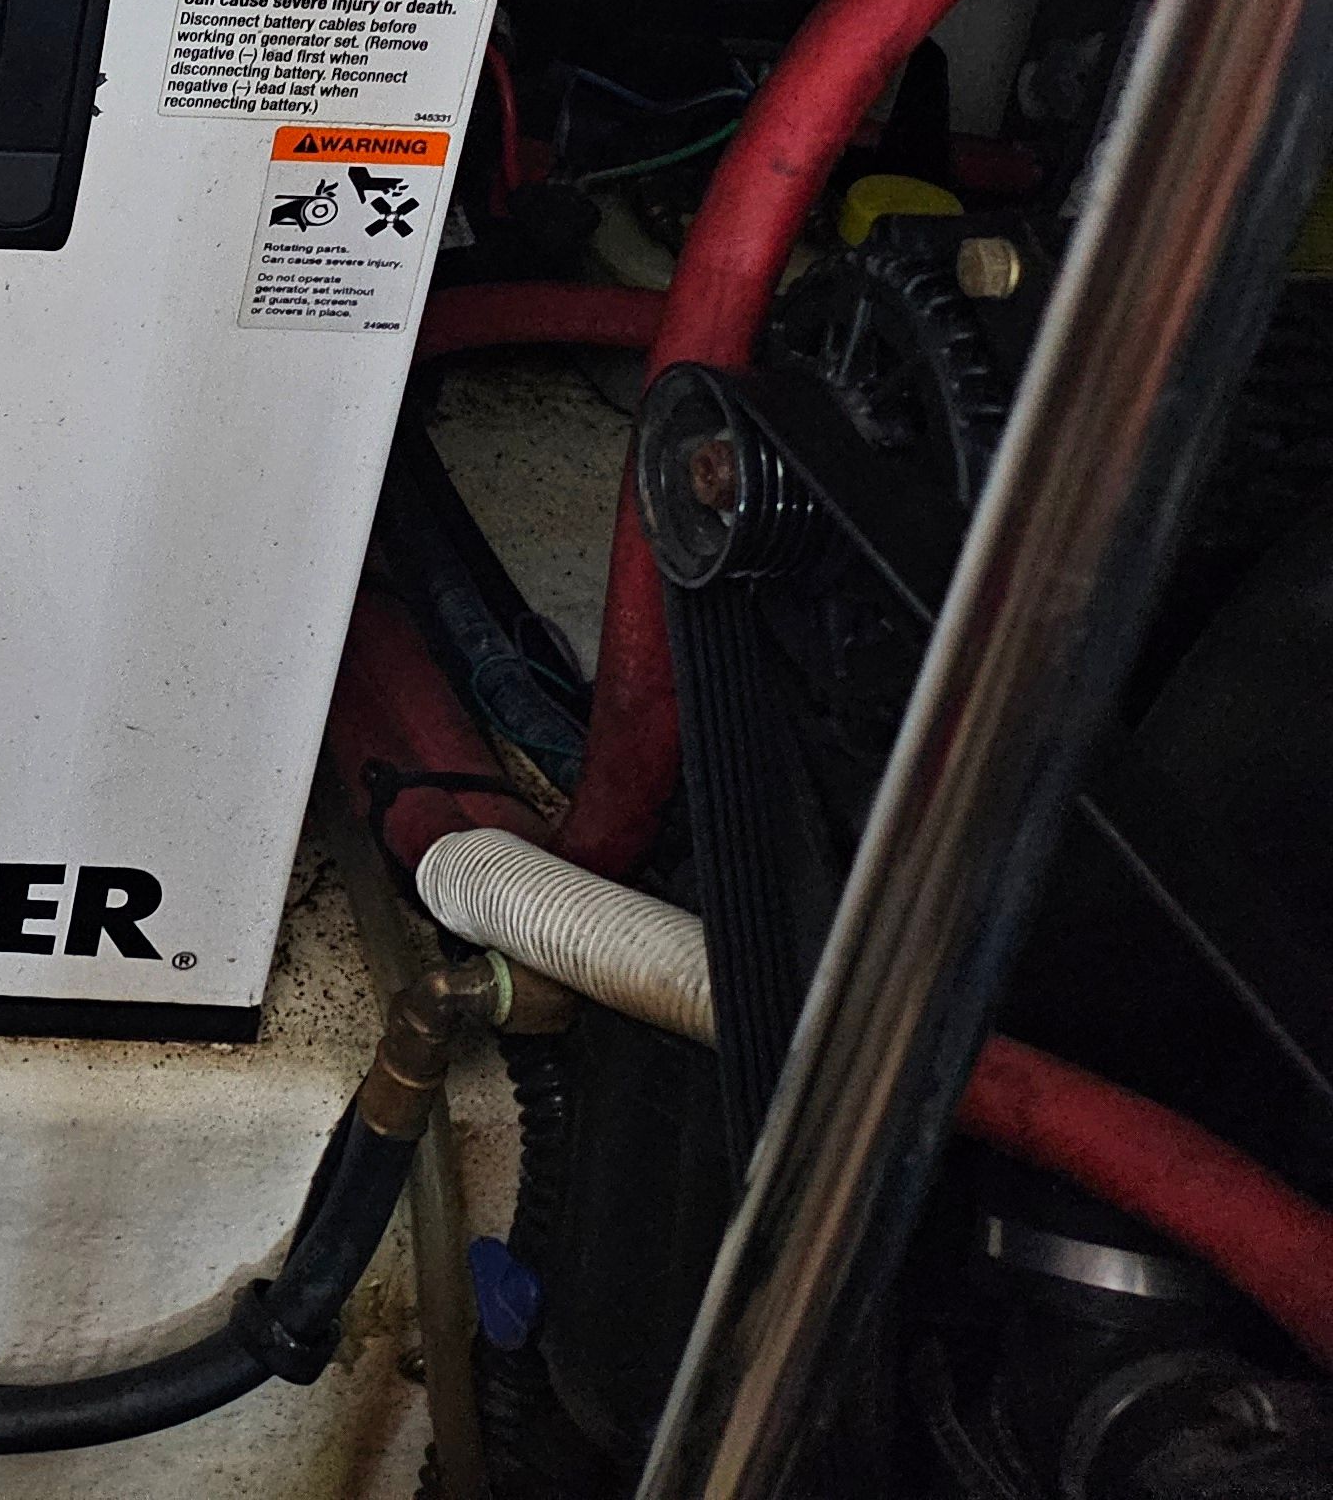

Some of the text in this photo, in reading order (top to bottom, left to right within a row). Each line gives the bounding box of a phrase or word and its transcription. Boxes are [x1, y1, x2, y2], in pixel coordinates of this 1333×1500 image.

[383, 0, 403, 13] or
[179, 10, 417, 35] Disconnect battery cables before
[177, 27, 429, 52] working on generator set. (Remove
[173, 44, 235, 61] negative
[261, 46, 294, 63] lead
[296, 47, 326, 64] first
[329, 49, 369, 66] when
[170, 60, 408, 84] disconnecting battery. Reconnect
[167, 77, 229, 93] negative
[254, 79, 287, 95] lead
[288, 80, 318, 97] last
[319, 82, 359, 99] when
[163, 94, 319, 115] reconnecting battery.)
[320, 135, 427, 155] WARNING
[263, 241, 350, 255] Rotating parts.
[261, 253, 403, 270] Can cause severe injury.
[257, 271, 342, 285] Do not operate
[254, 284, 375, 297] generator set without
[252, 293, 358, 307] all guards, screens
[250, 306, 352, 318] or covers in place.
